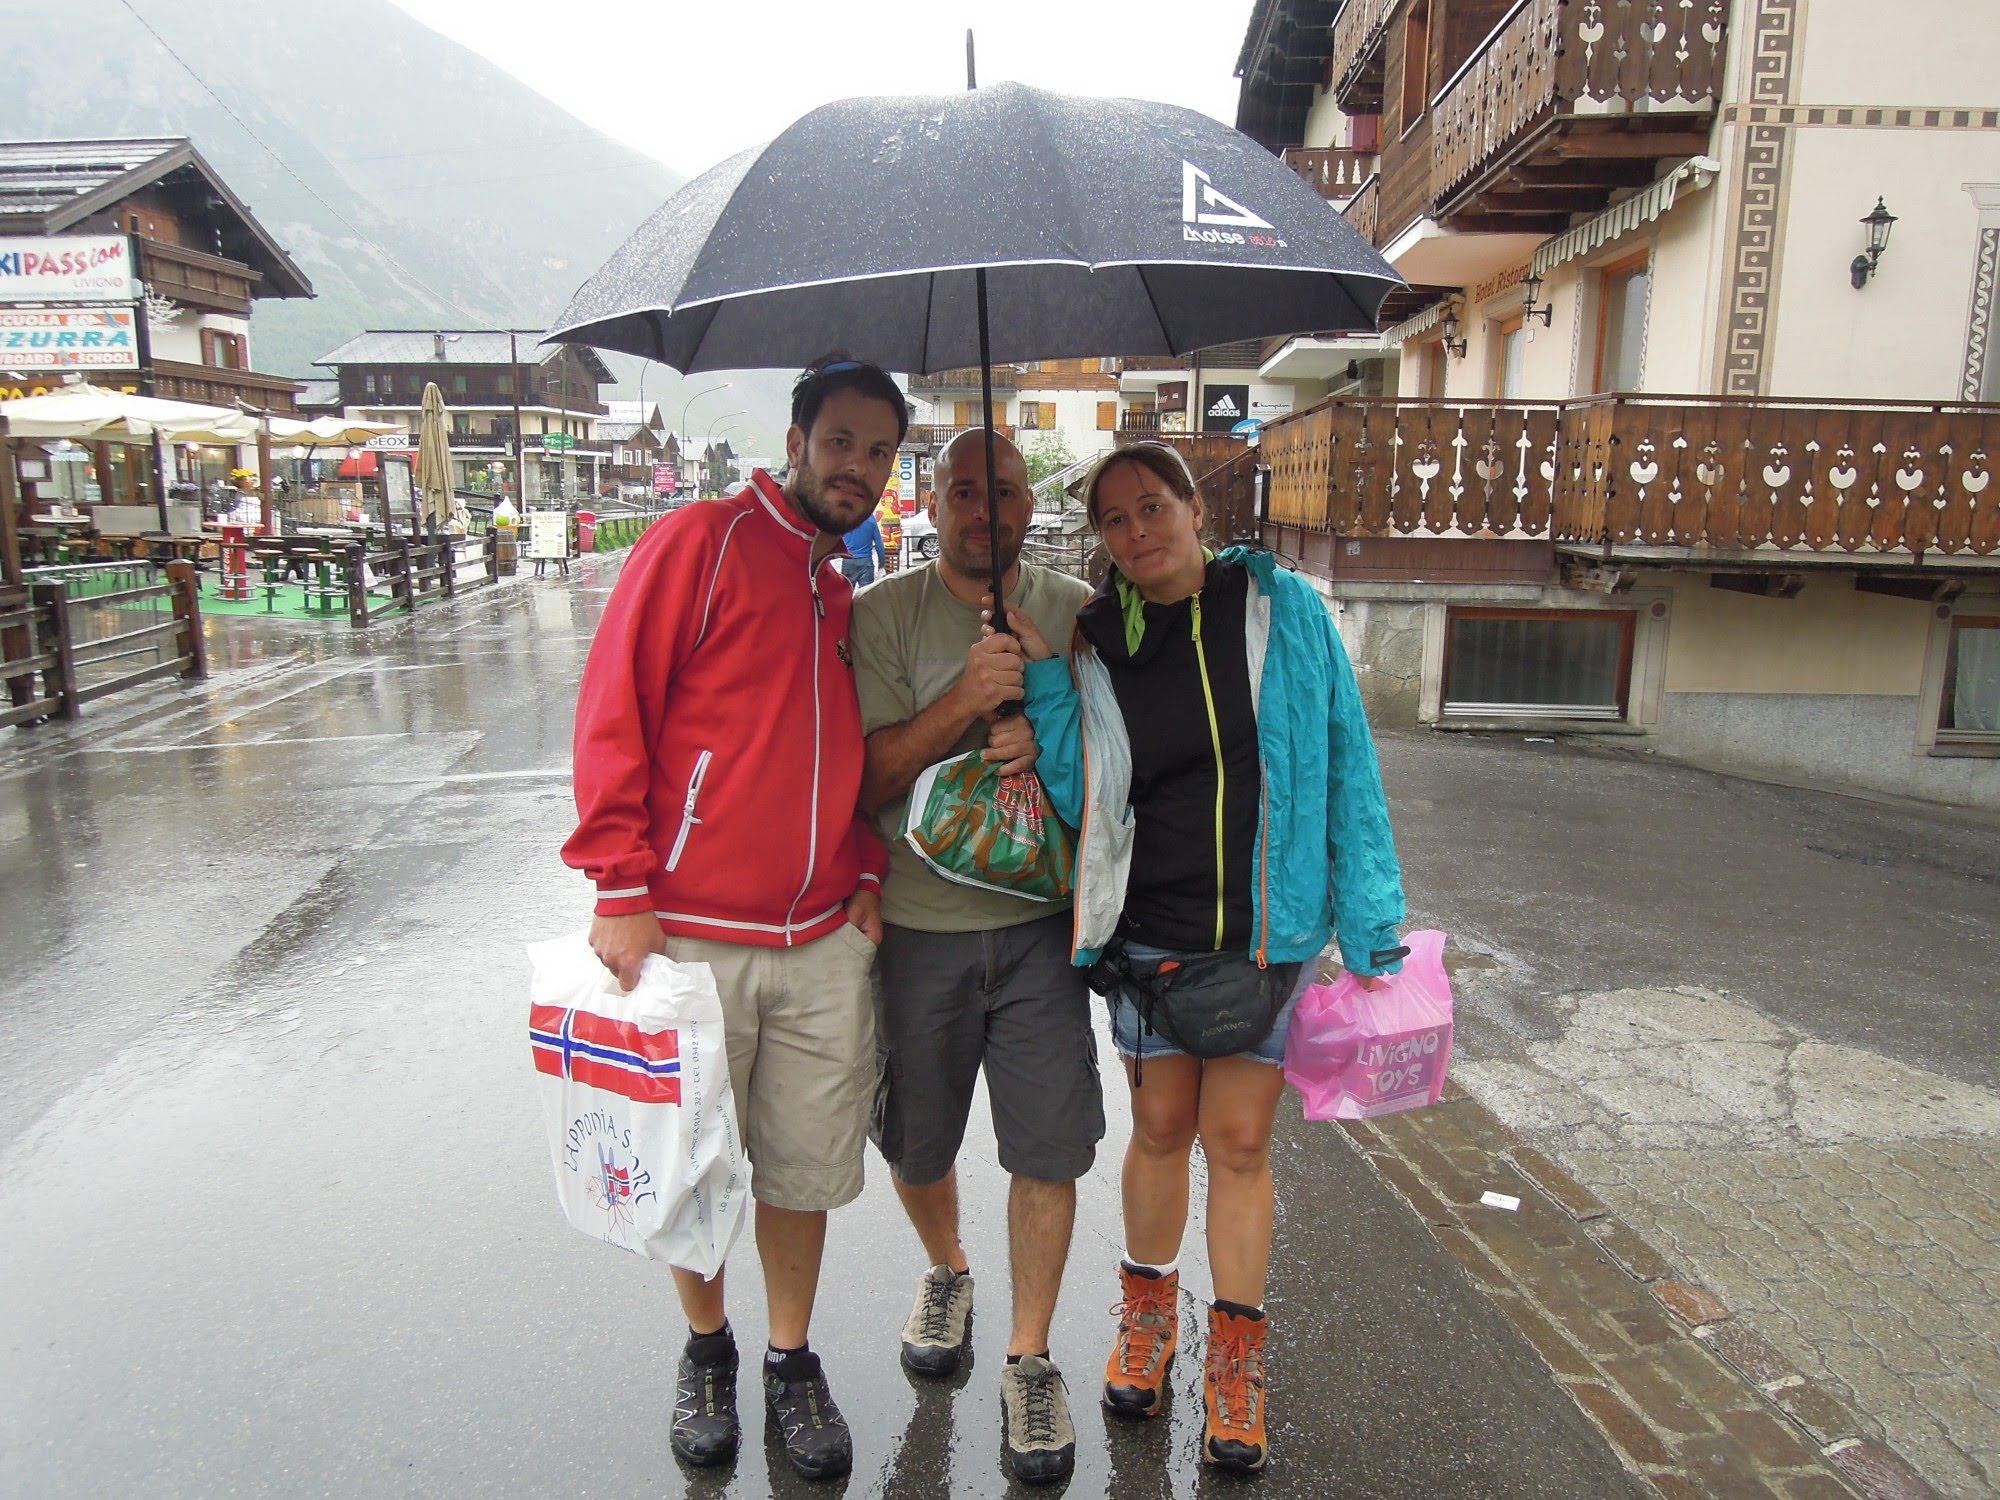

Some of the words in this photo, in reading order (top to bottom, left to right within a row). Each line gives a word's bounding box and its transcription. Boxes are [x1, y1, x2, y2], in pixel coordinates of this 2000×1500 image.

[73, 277, 123, 288] LIVIGNO
[1475, 276, 1495, 304] Hotel
[0, 314, 61, 326] CUOLA
[0, 330, 129, 348] ZURRA
[77, 352, 132, 364] SCHOOL
[1207, 408, 1241, 417] adidas
[368, 437, 407, 447] GEOX
[1366, 1062, 1423, 1097] TOYS
[564, 1108, 618, 1173] LAPPONIA
